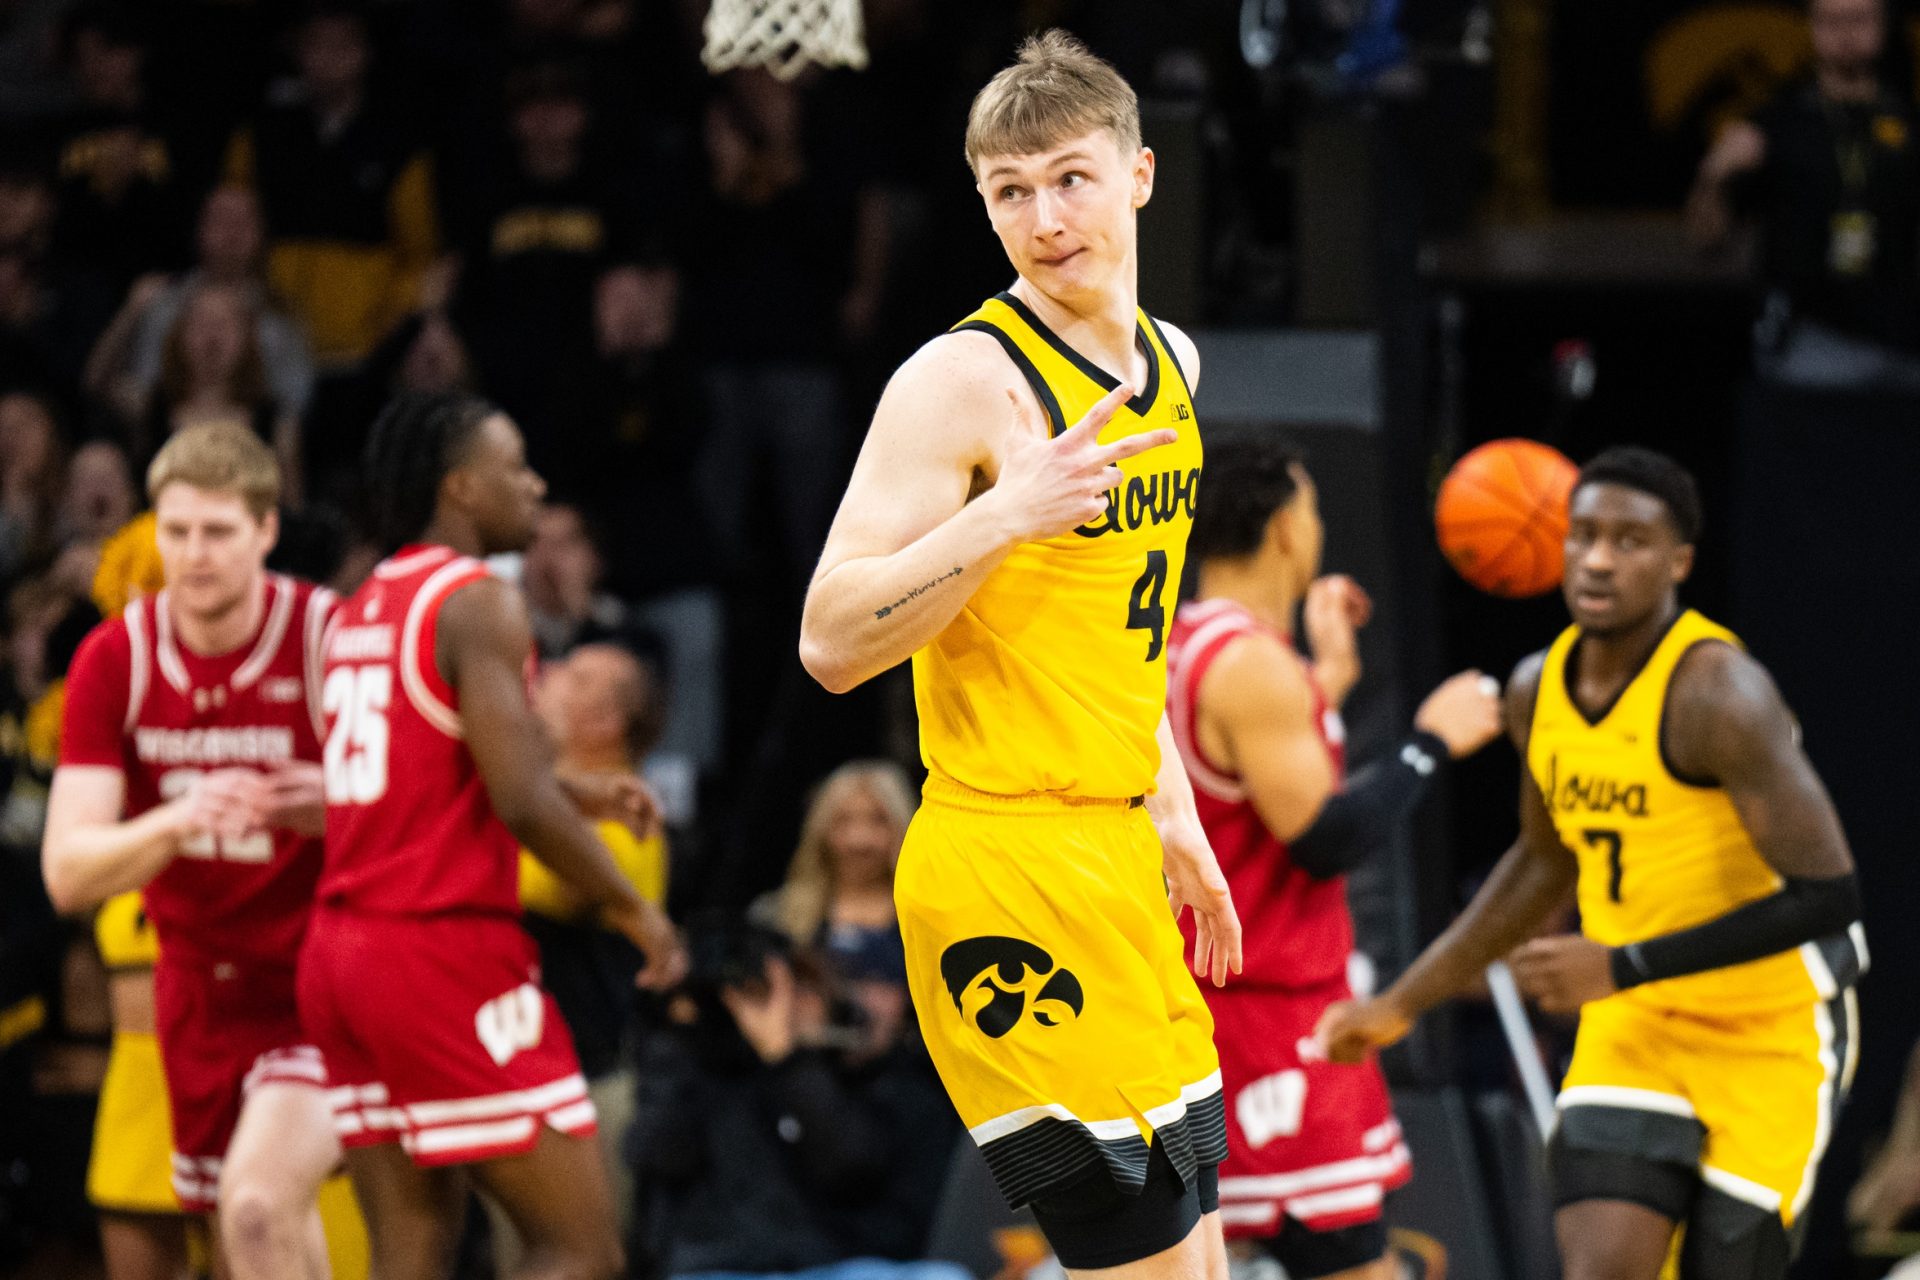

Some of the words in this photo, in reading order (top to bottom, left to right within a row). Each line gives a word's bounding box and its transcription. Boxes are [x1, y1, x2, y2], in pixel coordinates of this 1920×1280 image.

[1125, 549, 1168, 662] 4
[135, 726, 295, 764] WISCONSIN
[322, 663, 392, 806] 25
[1545, 752, 1651, 819] Iowa
[1581, 828, 1623, 904] 7
[474, 982, 545, 1068] W
[1235, 1069, 1309, 1150] W
